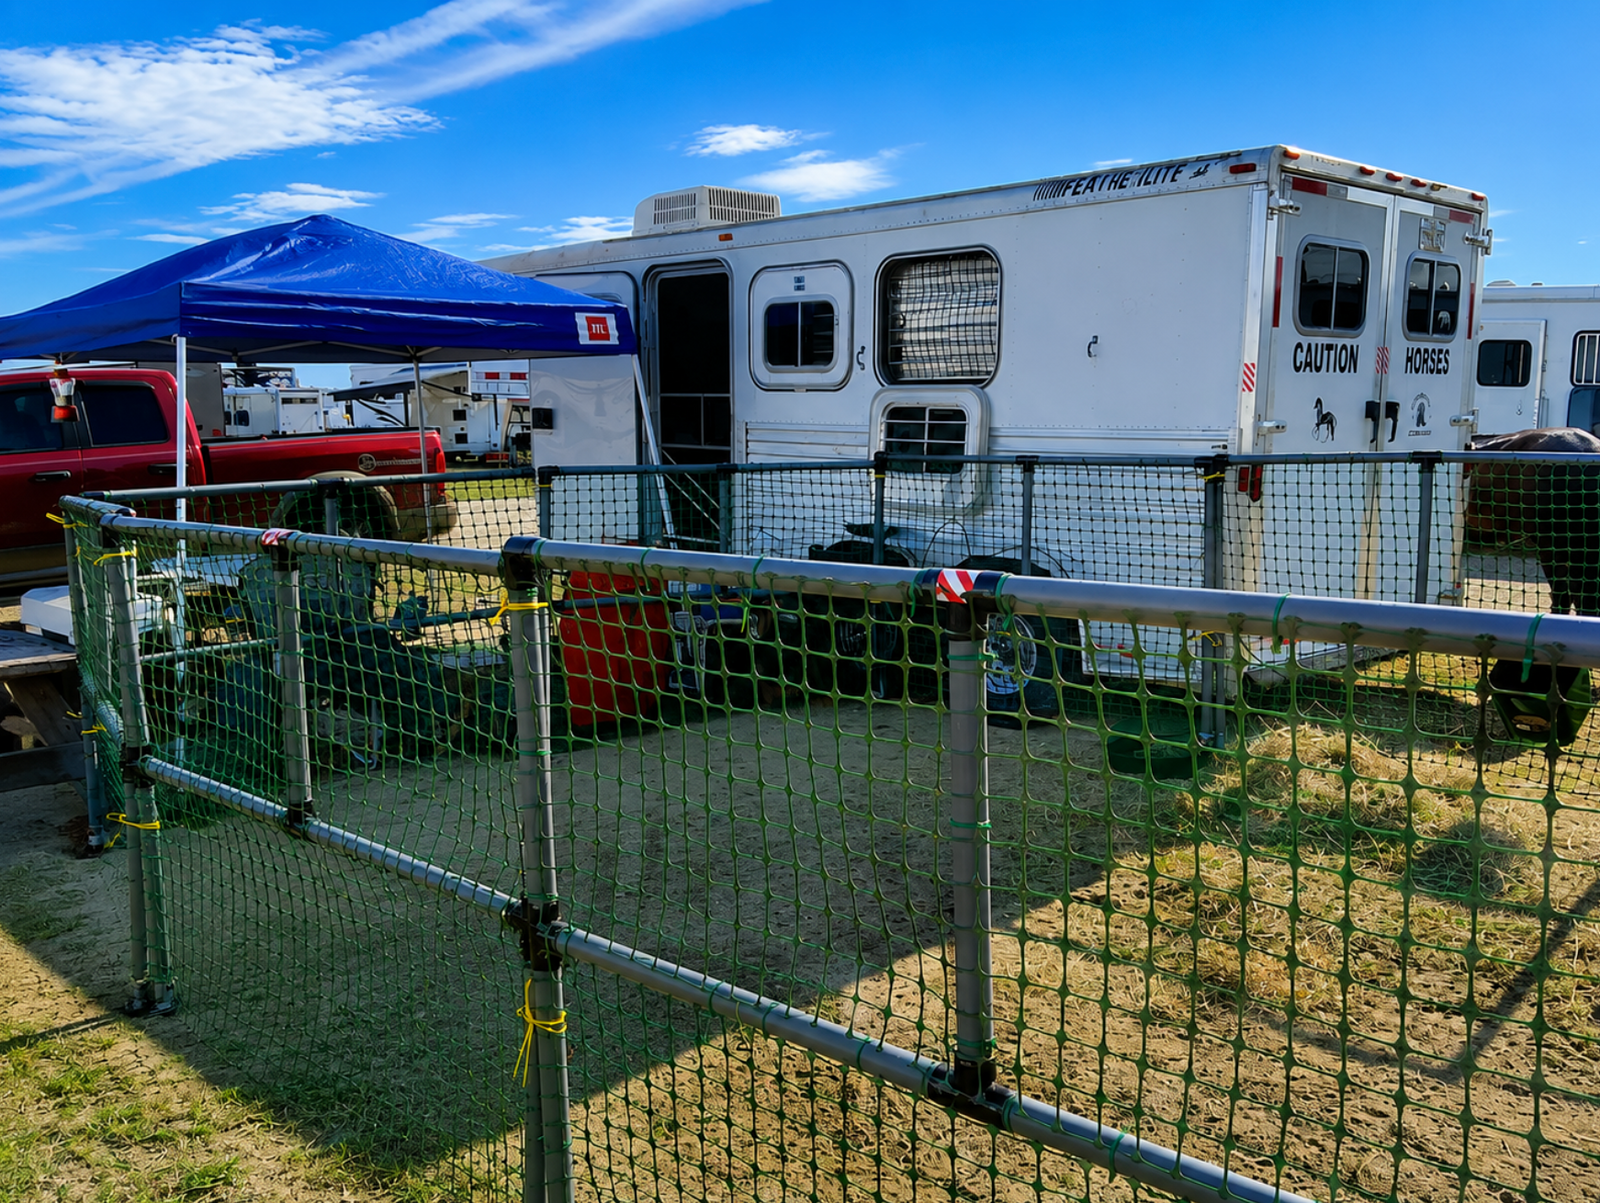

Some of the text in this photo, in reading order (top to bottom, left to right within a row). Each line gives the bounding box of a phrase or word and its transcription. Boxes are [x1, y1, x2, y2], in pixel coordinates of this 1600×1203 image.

[1061, 163, 1188, 198] FEATHELITE
[1292, 342, 1360, 374] CAUTION
[1404, 347, 1451, 375] HORSES
